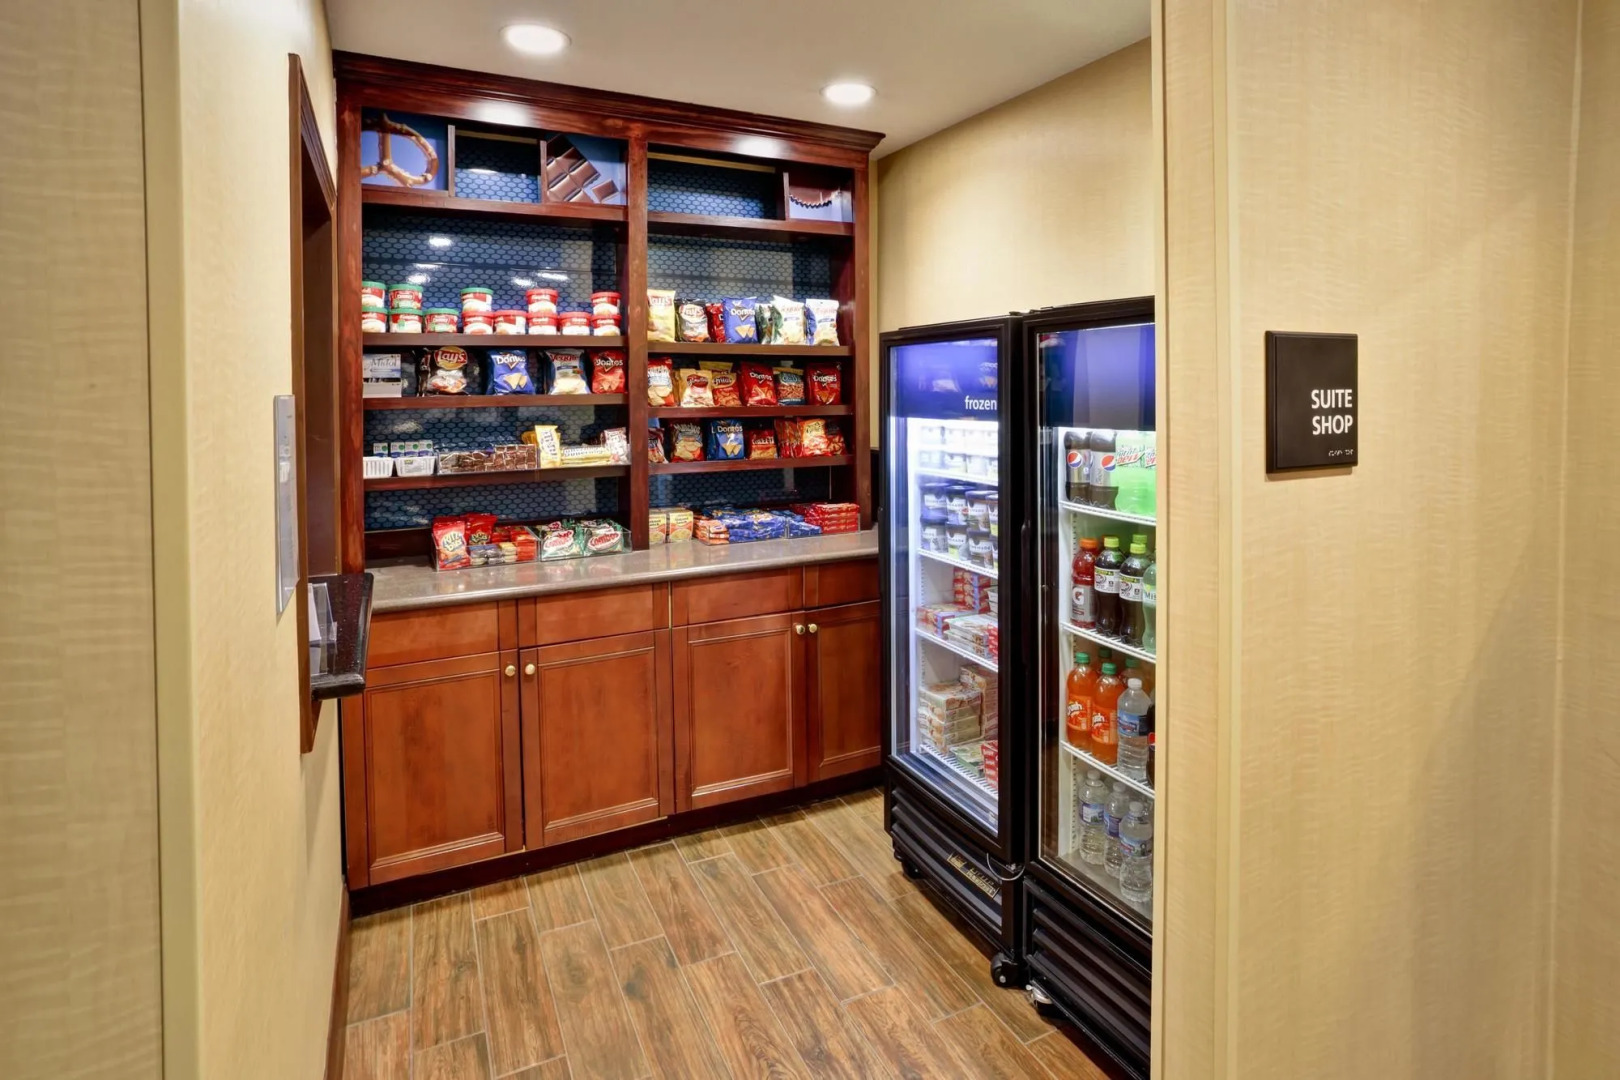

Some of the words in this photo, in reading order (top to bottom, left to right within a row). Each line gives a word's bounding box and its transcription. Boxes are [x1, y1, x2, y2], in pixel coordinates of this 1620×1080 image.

[965, 395, 997, 410] frozen
[1311, 389, 1353, 409] SUITE
[1312, 415, 1354, 436] SHOP
